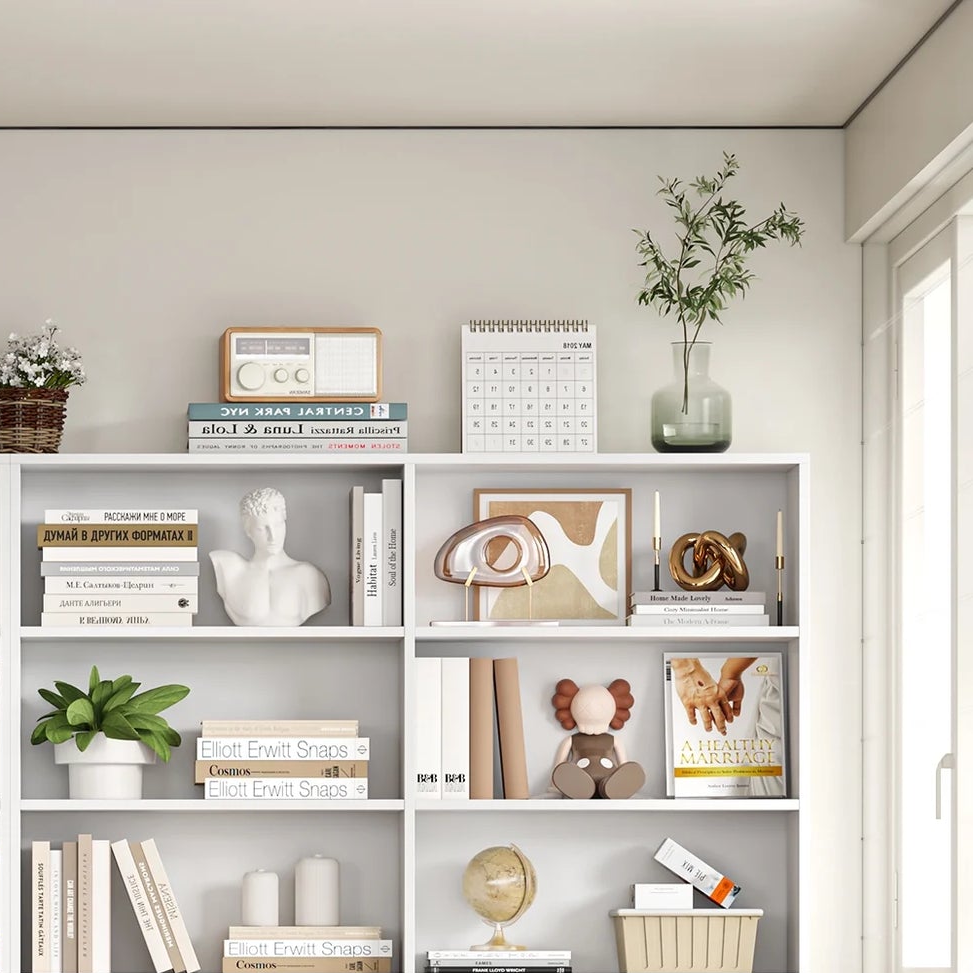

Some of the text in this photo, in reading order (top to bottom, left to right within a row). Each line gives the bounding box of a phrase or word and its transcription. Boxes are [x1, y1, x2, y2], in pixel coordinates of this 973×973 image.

[104, 512, 186, 521] РАССКАЖИ МНЕ О МОРЕ
[43, 528, 184, 542] ДУМАЙ В ДРУГИХ ФОРМАТАХ
[388, 529, 396, 586] Soul the Home
[201, 741, 348, 760] Elliott Erwitt Snaps
[682, 740, 775, 751] A HEALTHY
[680, 752, 776, 764] MARRIAGE
[209, 765, 251, 777] Cosmos
[208, 781, 347, 799] Elliott Erwitt Snaps
[229, 942, 372, 958] Elliott Erwitt Snaps
[236, 960, 276, 969] Cosmos
